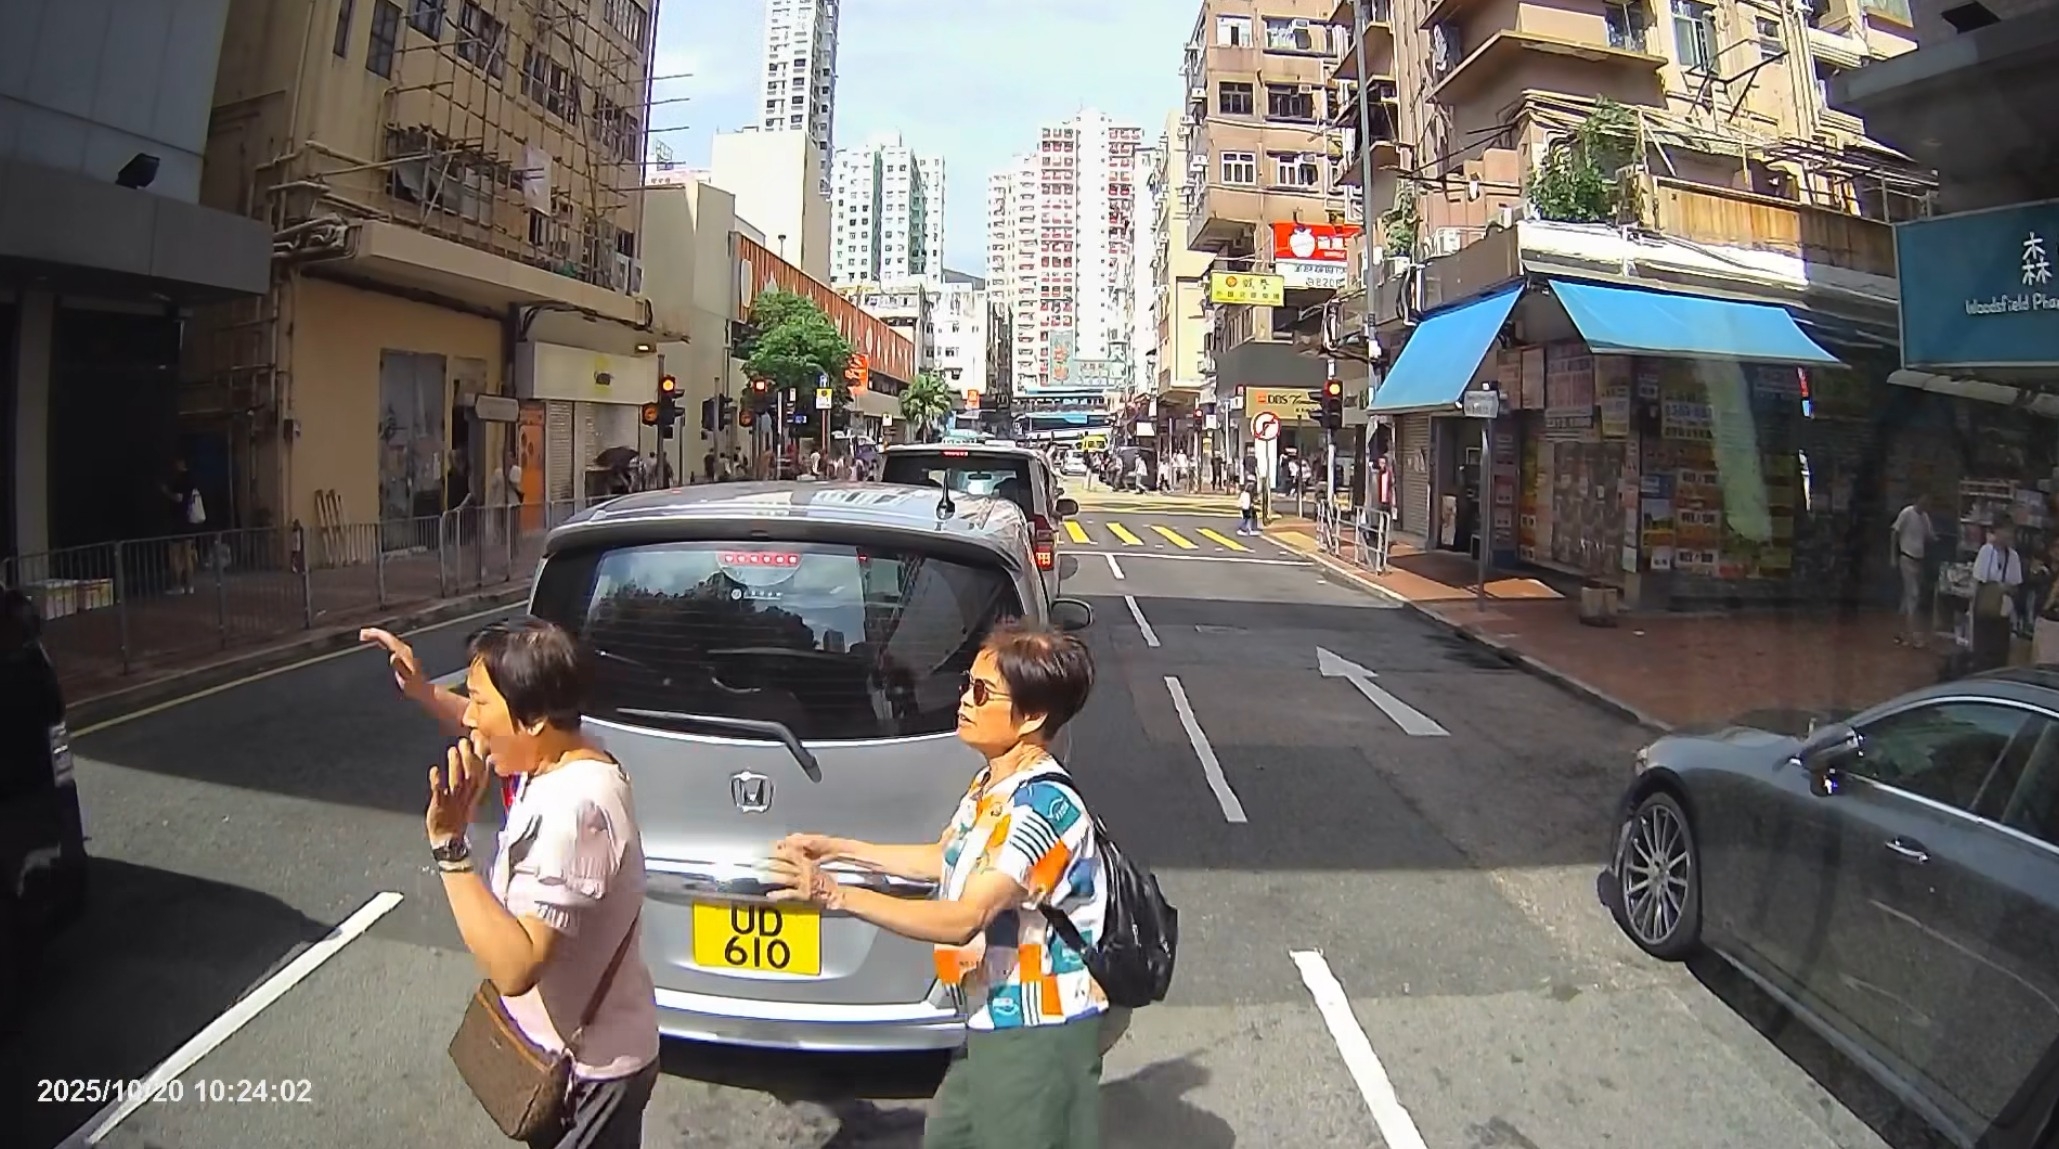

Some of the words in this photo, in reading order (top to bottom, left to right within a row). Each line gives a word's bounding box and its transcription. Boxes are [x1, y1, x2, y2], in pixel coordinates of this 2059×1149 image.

[2022, 231, 2052, 285] 森
[1965, 293, 2029, 315] Woodsfield
[731, 904, 783, 937] UD
[724, 935, 791, 969] 610
